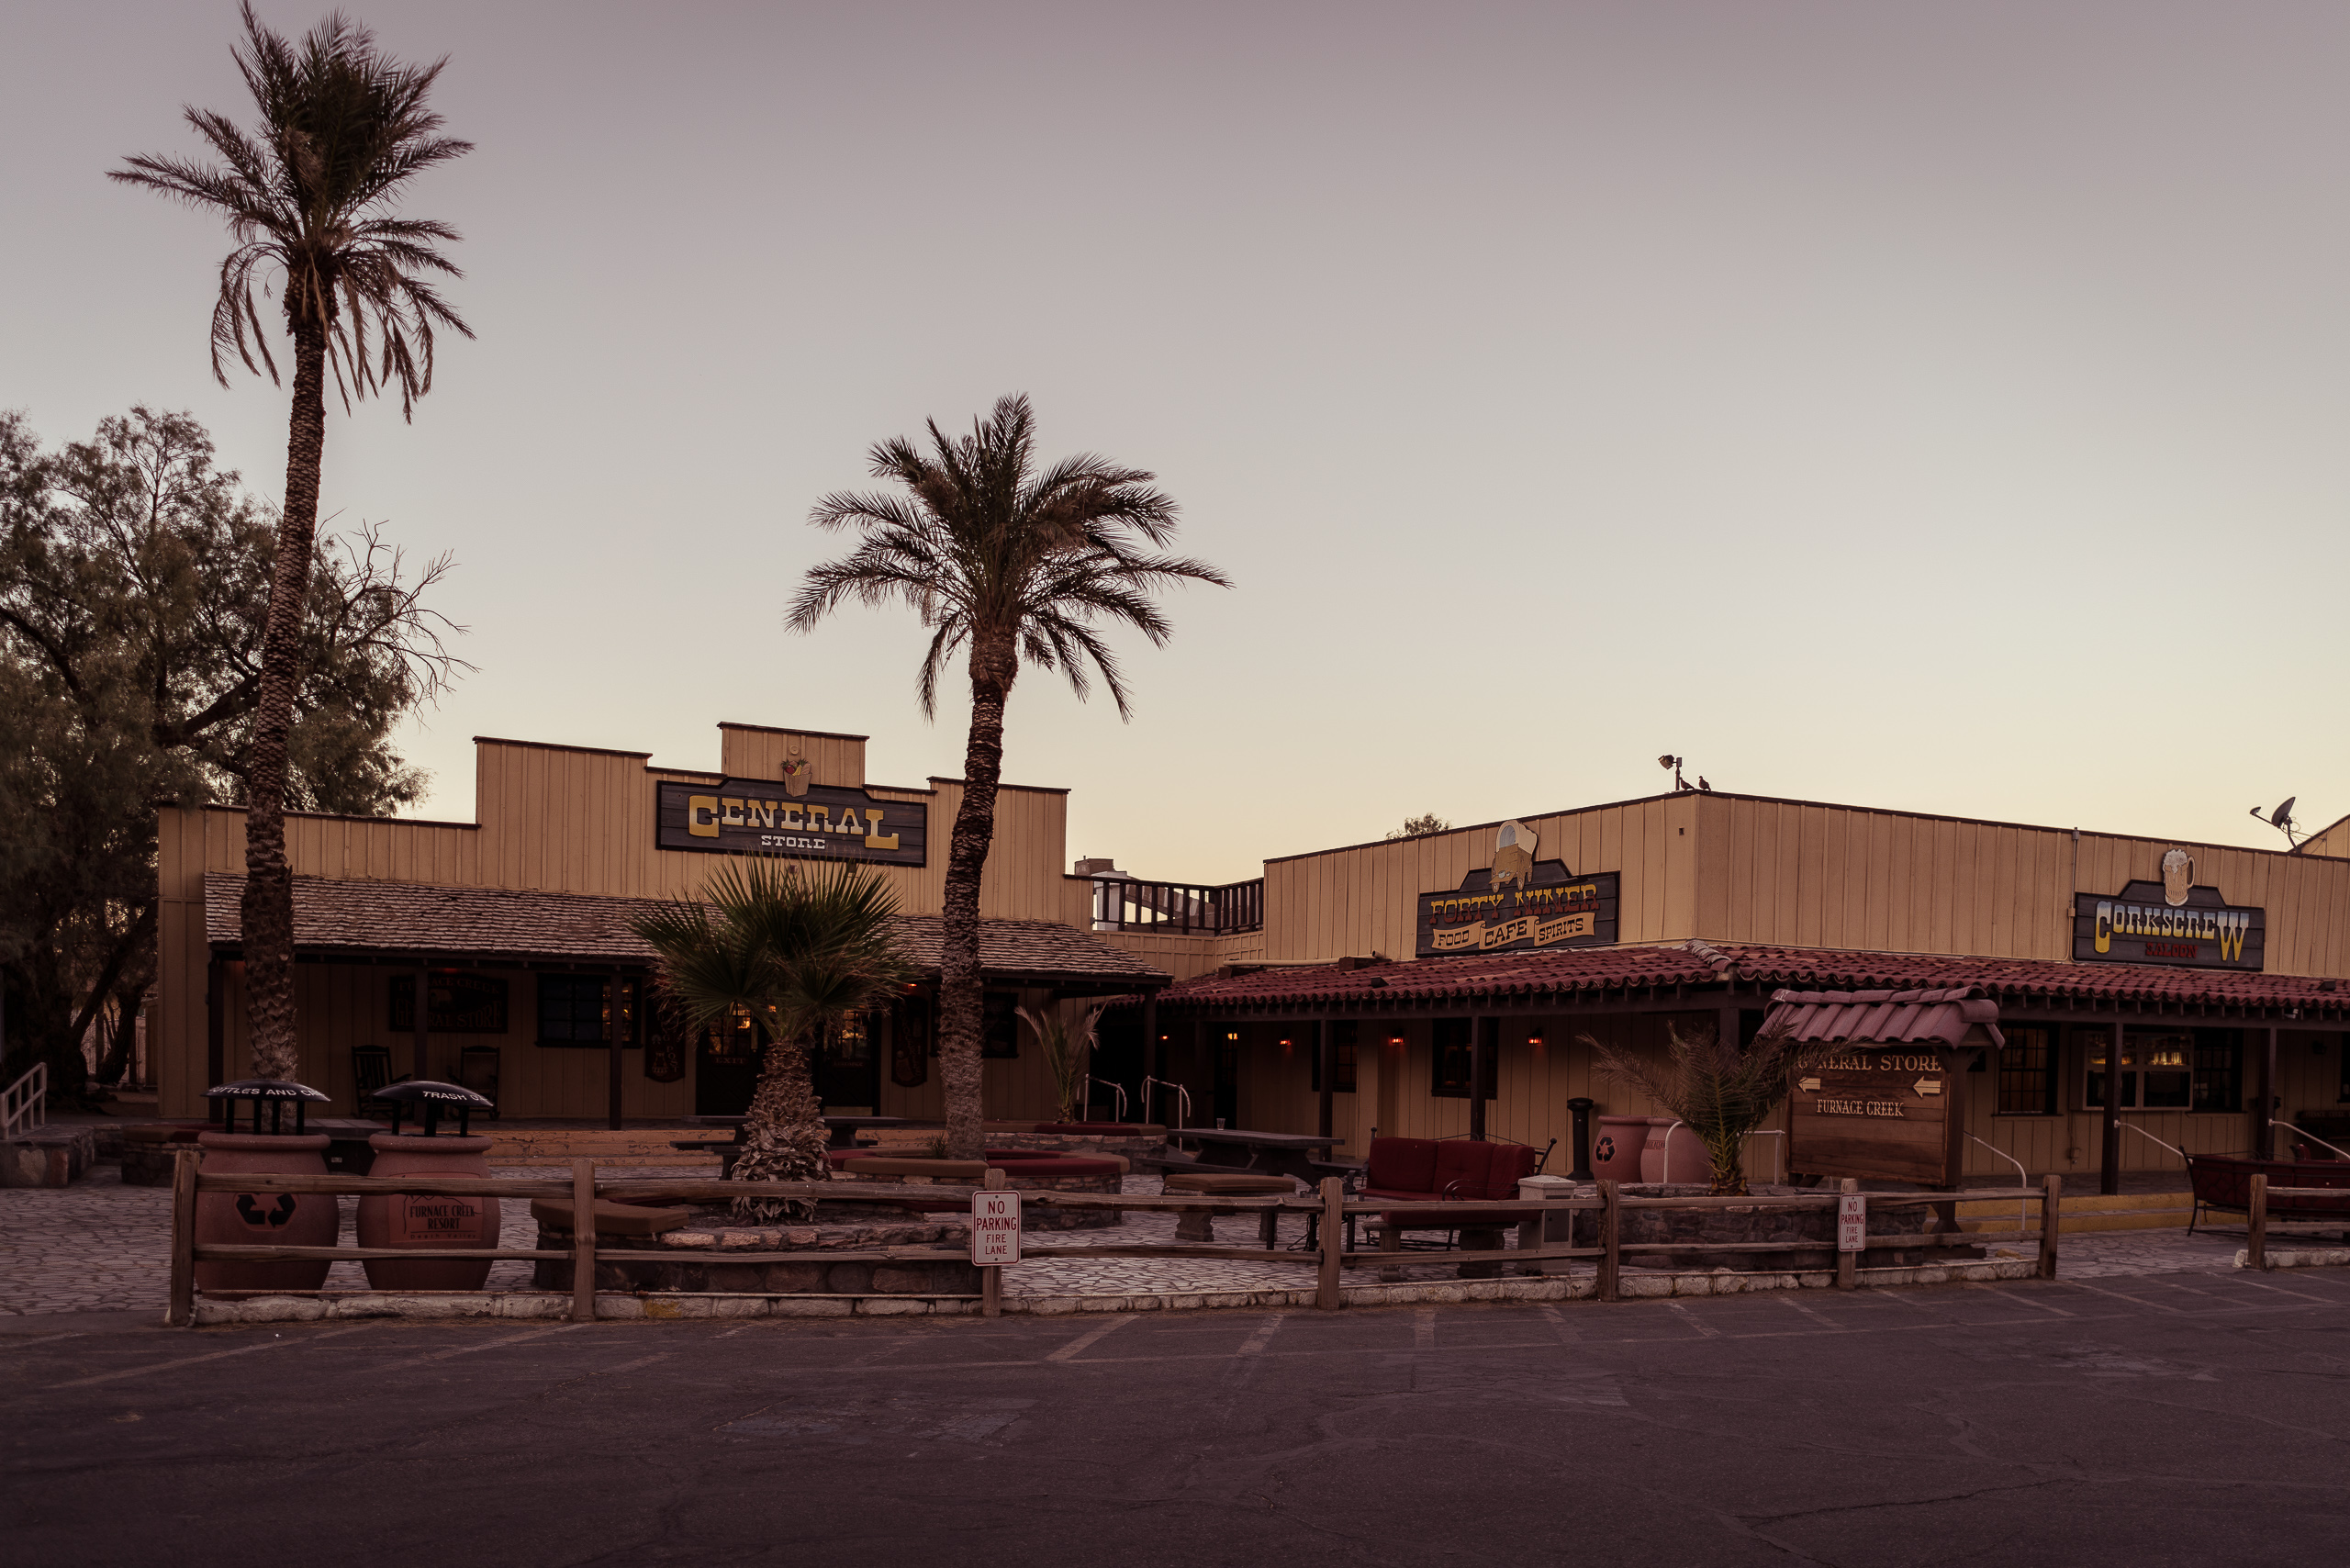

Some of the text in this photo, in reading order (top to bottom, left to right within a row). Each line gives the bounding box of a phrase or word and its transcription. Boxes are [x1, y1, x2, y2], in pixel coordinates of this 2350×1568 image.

[688, 795, 899, 850] GENERAL
[761, 834, 825, 849] STORE
[1429, 883, 1600, 924] FORTY NINER
[1438, 918, 1583, 947] FOOD CAFE SPIRITS
[2095, 901, 2249, 961] CORKSCREW
[2145, 942, 2199, 958] SALOON
[397, 978, 500, 994] FUACE CREEK
[396, 998, 503, 1028] GERAL STORE
[1798, 1055, 1942, 1071] GNERAL STORE
[422, 1091, 467, 1101] TRASH
[1817, 1099, 1905, 1117] FURNACE CREEK
[410, 1205, 476, 1217] FURNACE CREEK
[988, 1201, 1005, 1214] NO
[1848, 1201, 1858, 1212] NO
[428, 1218, 461, 1229] RESORT
[977, 1217, 1016, 1231] PARKING
[1841, 1214, 1863, 1225] PARKING
[986, 1234, 1006, 1243] FIRE
[985, 1245, 1007, 1254] LANE
